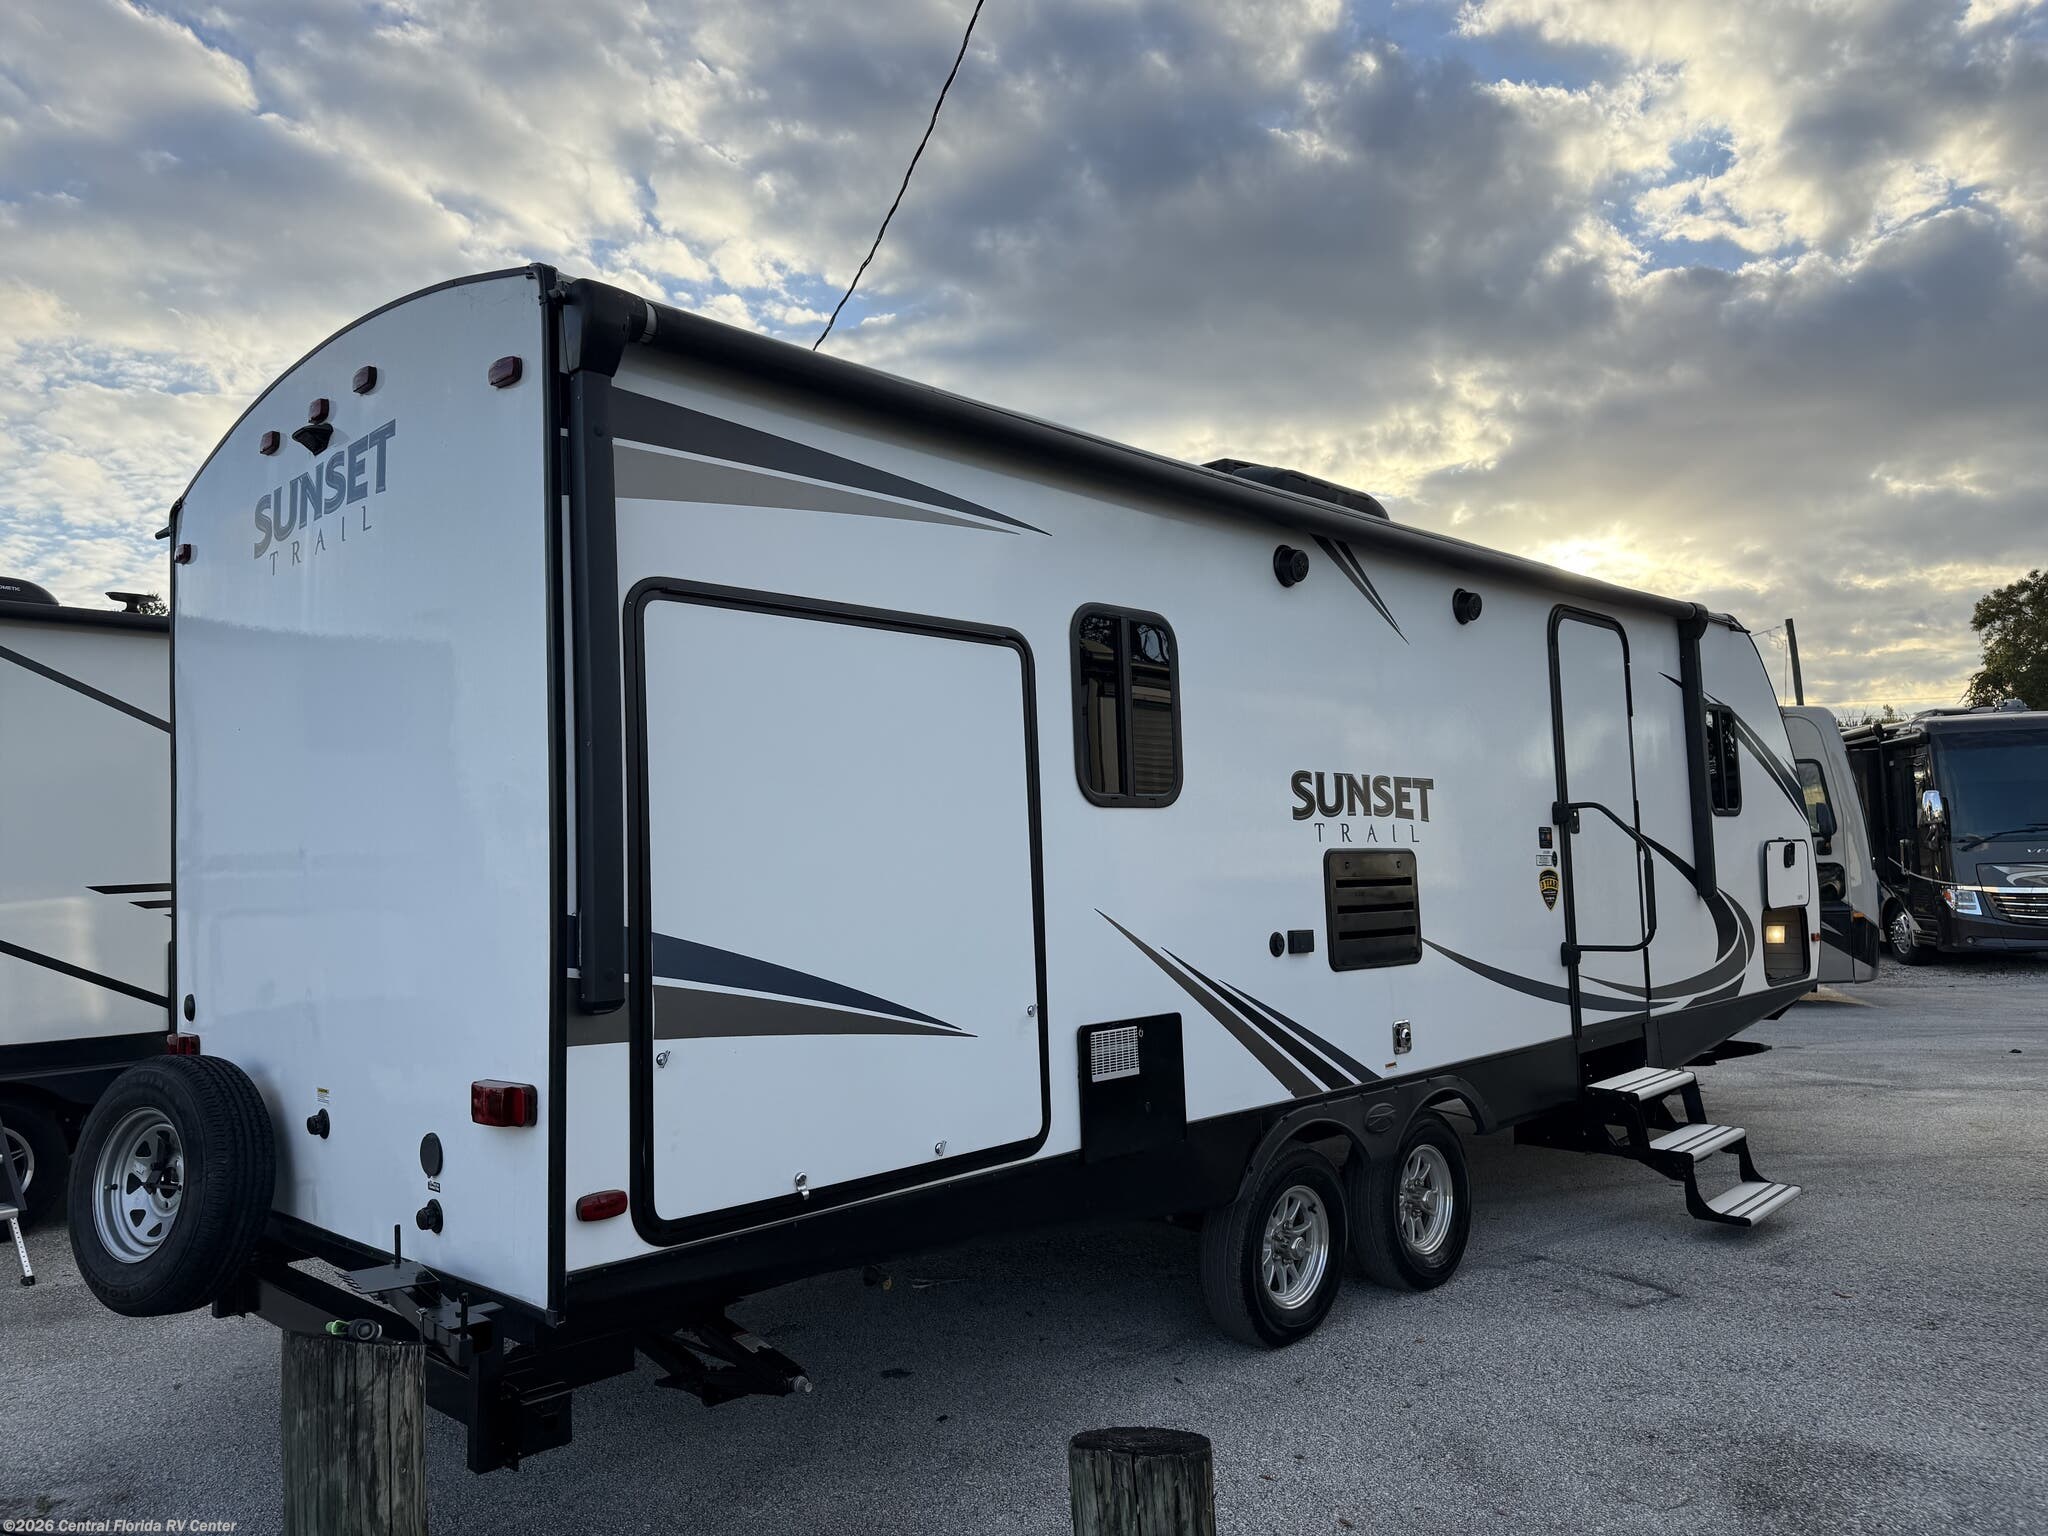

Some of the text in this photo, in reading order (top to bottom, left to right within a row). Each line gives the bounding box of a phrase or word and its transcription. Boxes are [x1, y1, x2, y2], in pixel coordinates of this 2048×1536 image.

[254, 419, 396, 560] SUNSET
[269, 505, 372, 577] TRAIL
[1291, 770, 1434, 822] SUNSET
[1314, 823, 1420, 843] TRAIL
